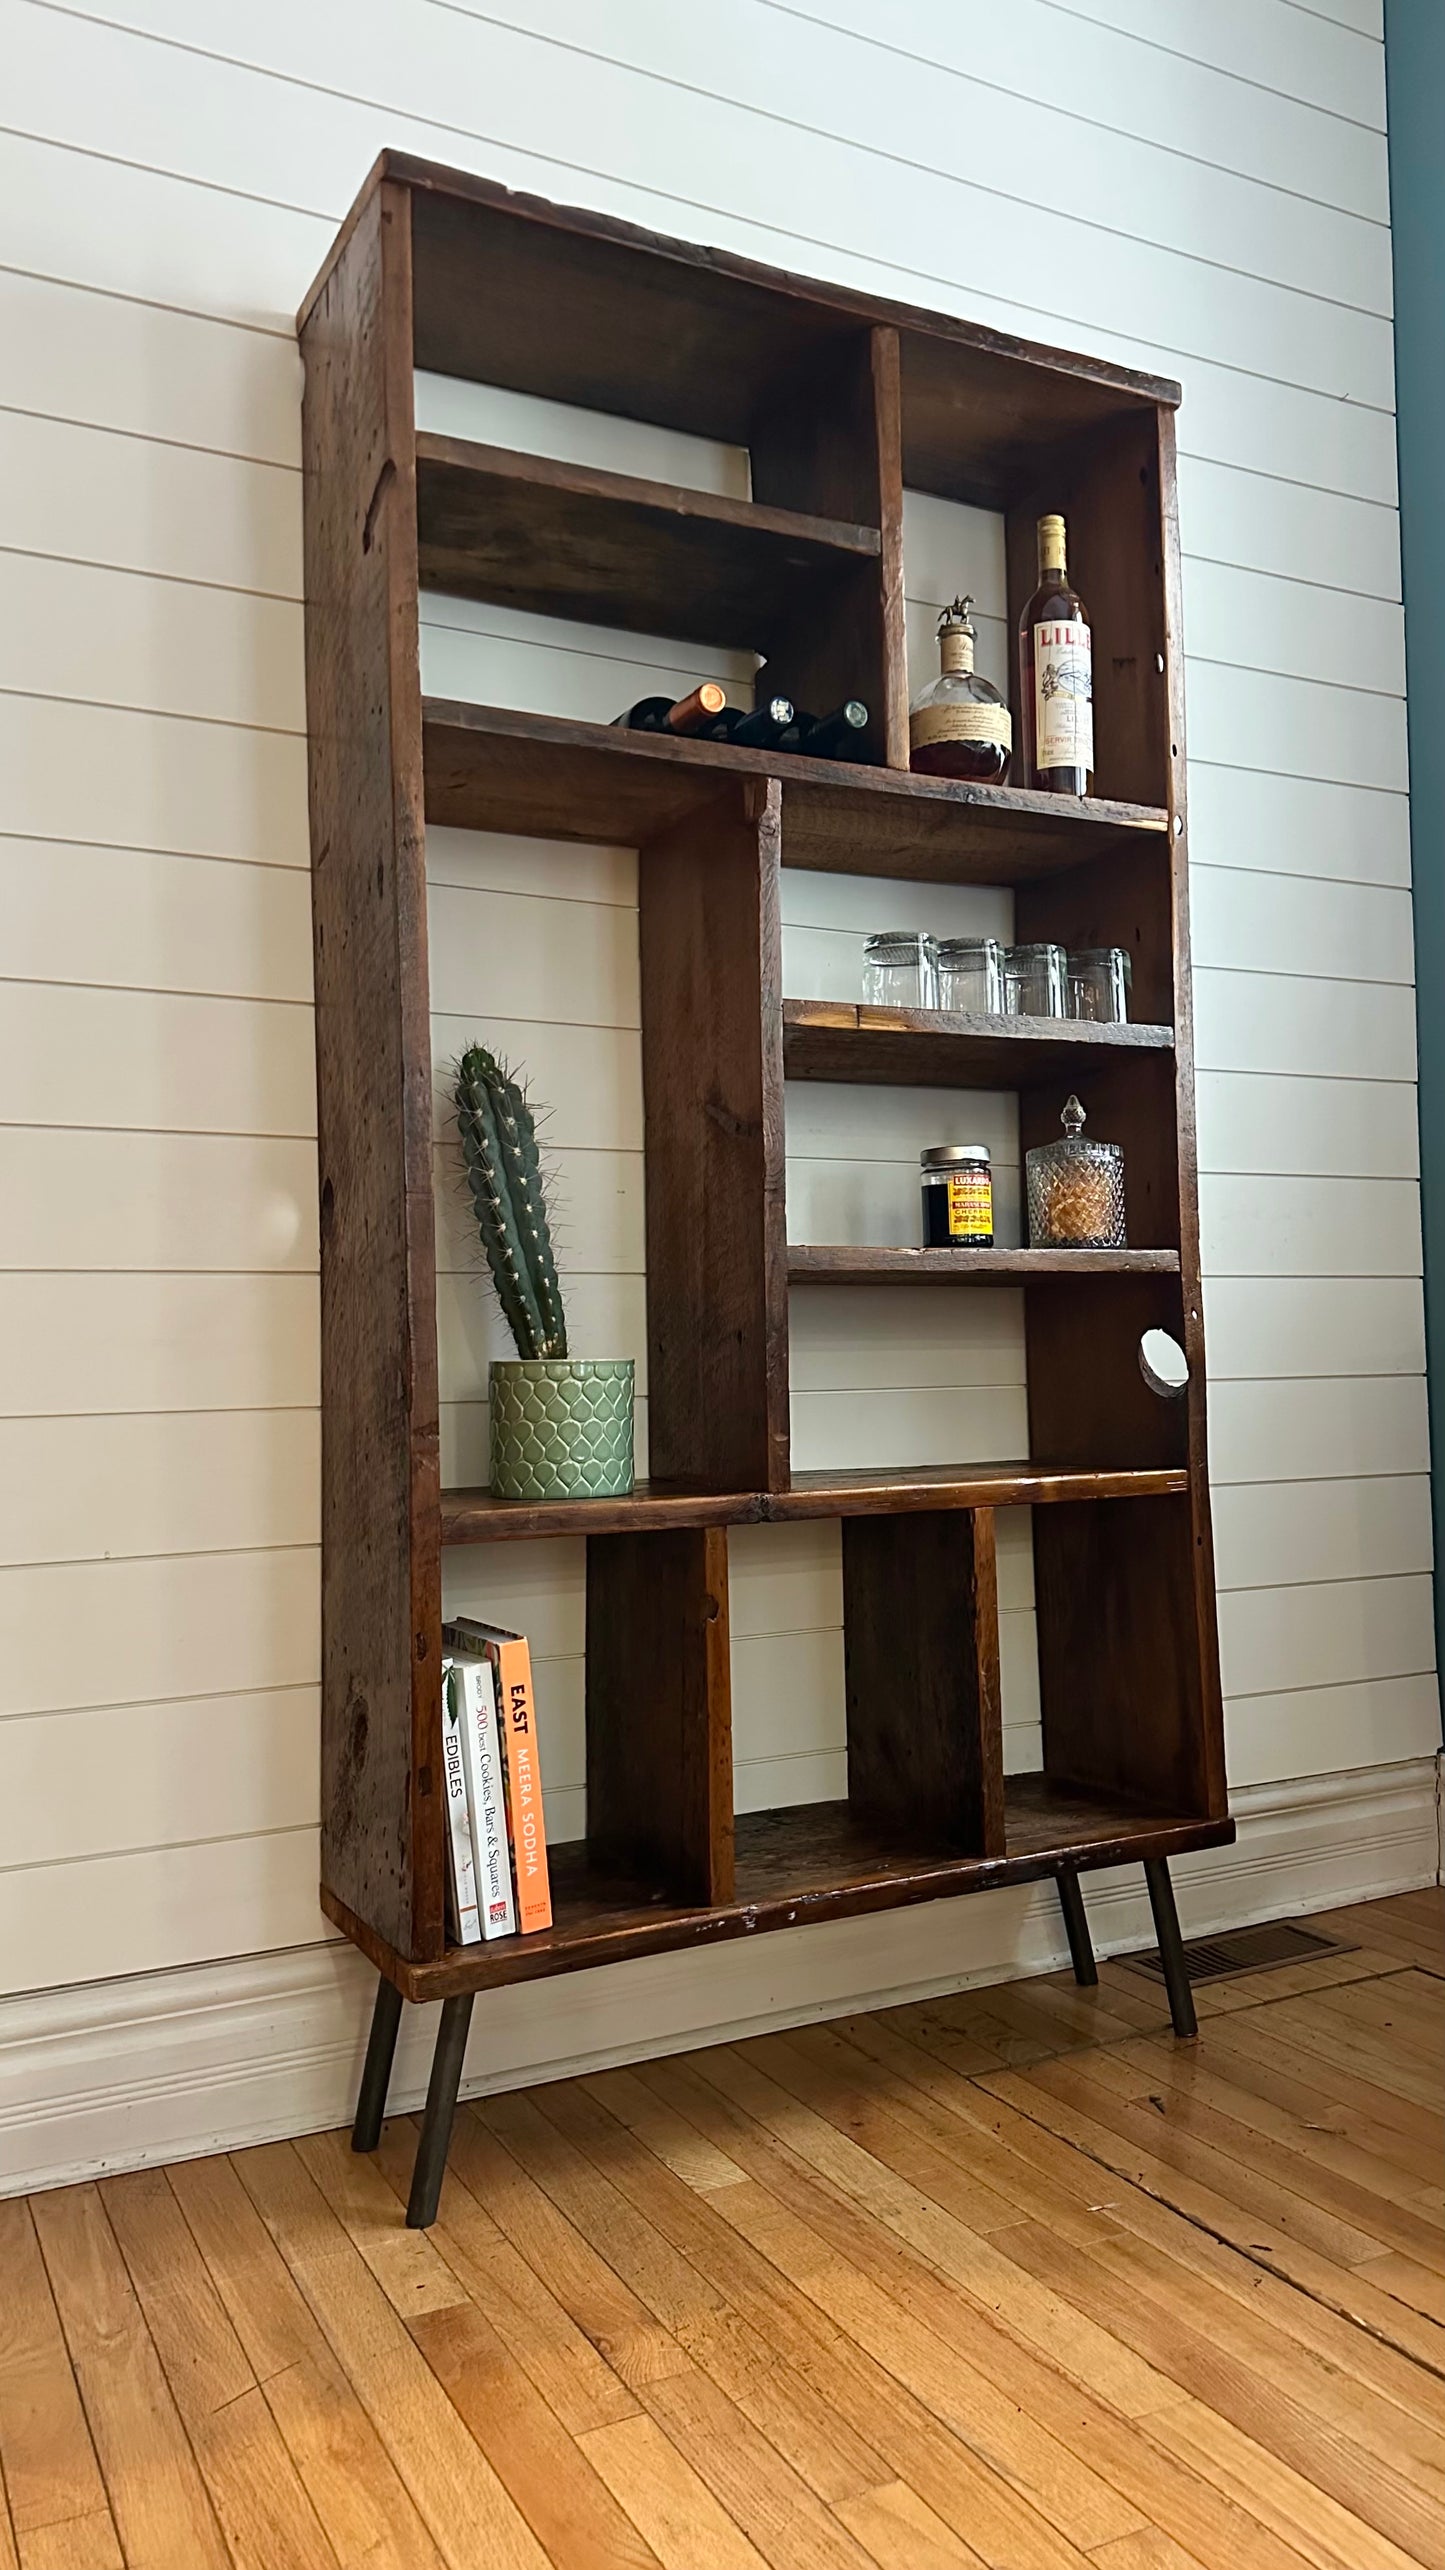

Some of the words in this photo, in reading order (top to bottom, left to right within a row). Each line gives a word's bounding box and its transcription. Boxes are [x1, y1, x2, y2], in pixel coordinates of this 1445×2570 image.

[476, 1705, 488, 1730] 500
[511, 1684, 528, 1734] EAST
[479, 1731, 487, 1752] best
[445, 1735, 463, 1798] EDIBLES
[480, 1754, 493, 1805] Cookies,
[517, 1748, 534, 1807] MEERA
[485, 1806, 496, 1834] Bars
[487, 1836, 498, 1847] &
[523, 1813, 538, 1877] SODHA
[486, 1850, 501, 1898] Squares
[490, 1911, 507, 1922] ROSE
